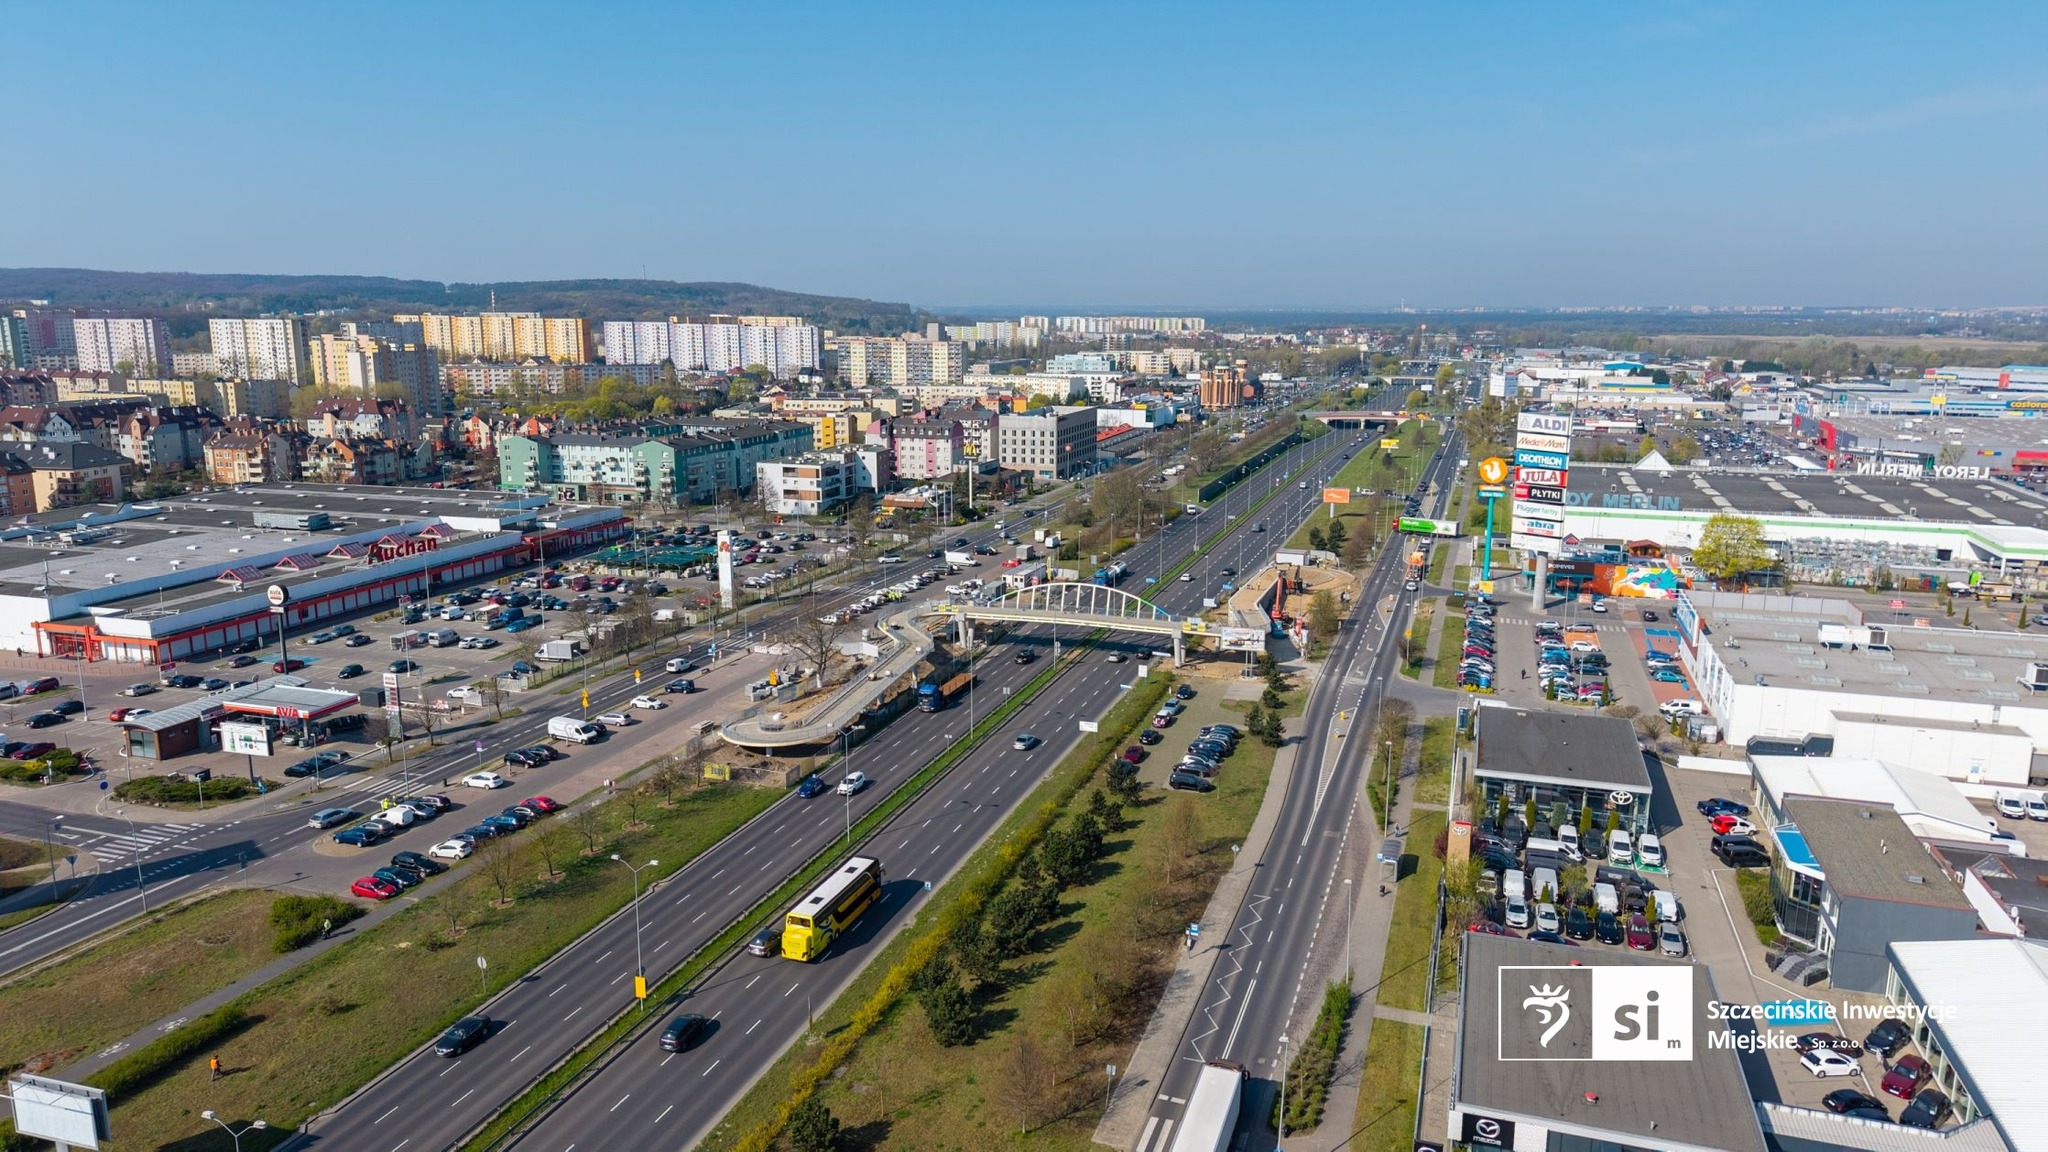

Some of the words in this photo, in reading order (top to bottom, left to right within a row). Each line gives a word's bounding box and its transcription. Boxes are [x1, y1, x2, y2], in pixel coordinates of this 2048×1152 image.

[1532, 417, 1567, 431] ALDI
[1519, 453, 1562, 466] DECATHLON
[1522, 471, 1559, 485] JULA
[1531, 488, 1561, 500] PŁYTKI
[1603, 493, 1680, 511] MERLIN
[1526, 520, 1555, 530] abra
[367, 537, 438, 565] Auchan
[1473, 1135, 1502, 1146] mazda
